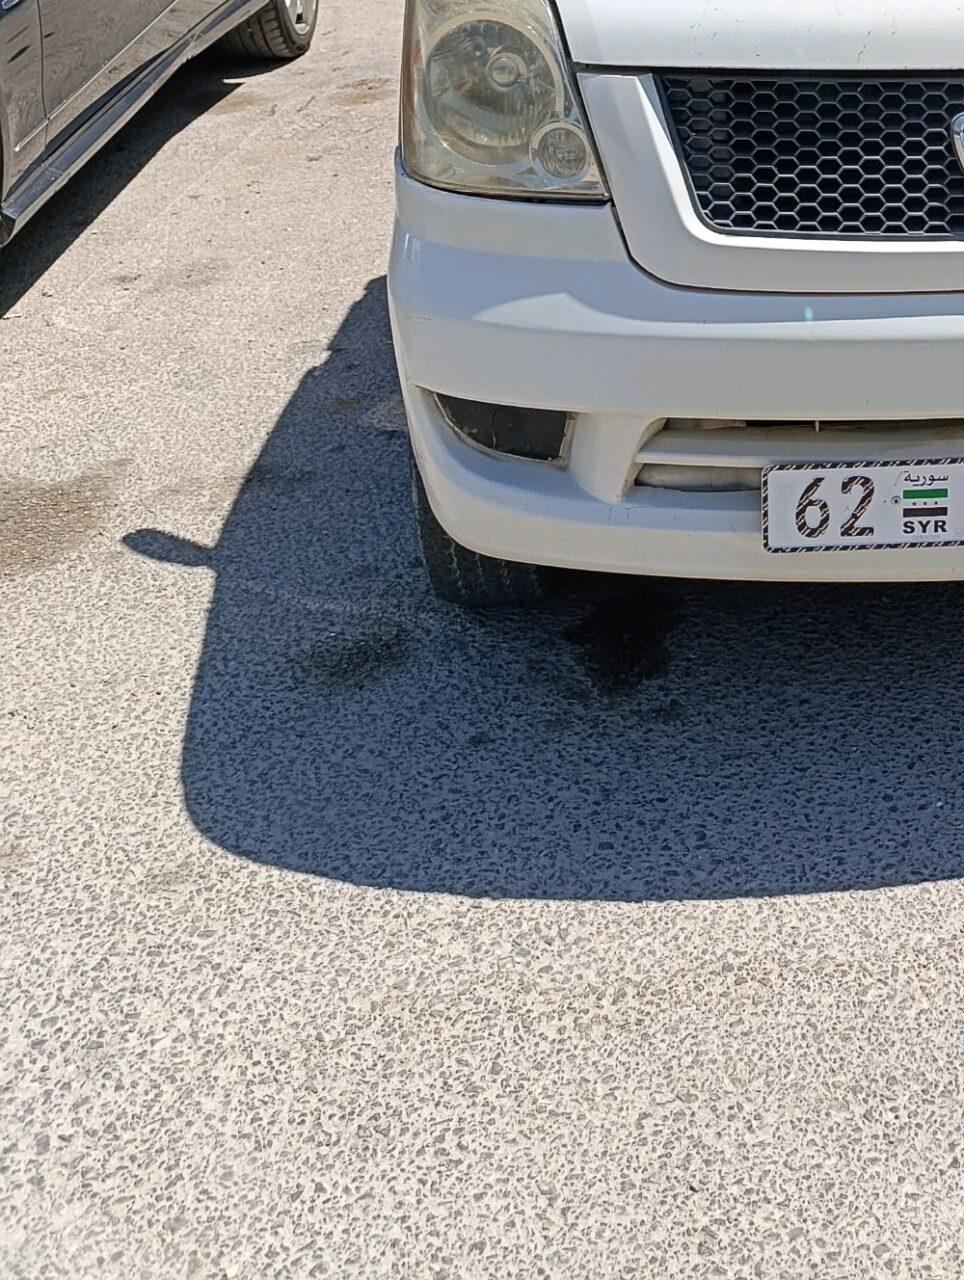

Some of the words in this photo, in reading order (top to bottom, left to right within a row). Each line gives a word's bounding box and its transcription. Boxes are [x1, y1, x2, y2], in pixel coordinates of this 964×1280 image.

[903, 470, 949, 487] سورية
[794, 475, 875, 538] 62
[902, 519, 948, 535] SYR
